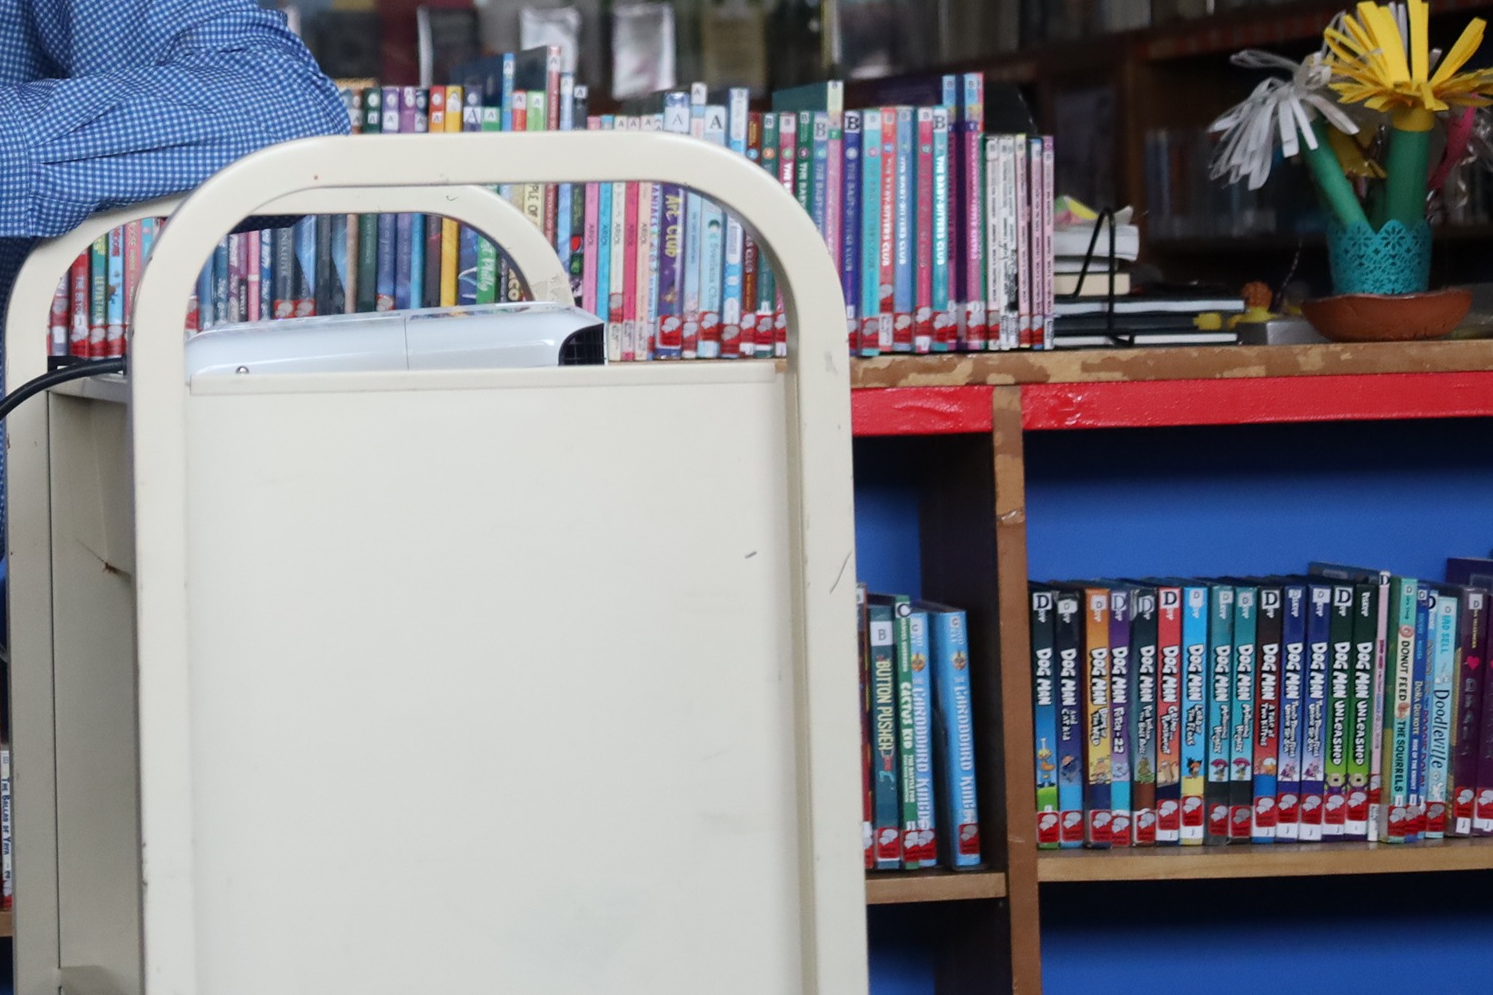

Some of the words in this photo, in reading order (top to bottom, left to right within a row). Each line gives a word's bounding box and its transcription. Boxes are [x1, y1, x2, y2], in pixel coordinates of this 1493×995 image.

[799, 162, 808, 179] THE
[937, 156, 945, 173] THE
[665, 195, 682, 222] Art
[936, 175, 945, 239] BABY-SITTERS
[665, 225, 682, 257] Club
[882, 242, 890, 266] CLUB
[937, 241, 945, 265] CLUB
[95, 276, 103, 317] LEVIATHA
[878, 629, 886, 640] B
[1440, 633, 1451, 654] SELL
[1036, 648, 1052, 677] DOG
[1060, 648, 1077, 677] DOG
[1090, 648, 1107, 677] DOG
[1112, 646, 1128, 675] DOG
[1139, 645, 1155, 673] DOG
[1162, 645, 1179, 673] DOG
[1187, 644, 1204, 671] DOG
[1214, 645, 1231, 672] DOG
[1237, 644, 1253, 672] DOG
[1262, 644, 1279, 672] DOG
[1286, 643, 1303, 670] DOG
[1310, 642, 1328, 669] DOG
[1333, 642, 1350, 669] DOG
[1355, 642, 1373, 669] DOG
[1399, 641, 1410, 674] DONUT
[875, 661, 892, 703] BUTTON
[1037, 679, 1052, 705] MAN
[1062, 680, 1076, 705] MAN
[1091, 679, 1107, 704] MAN
[1112, 677, 1127, 703] MAN
[1139, 676, 1154, 702] MAN
[1162, 674, 1178, 702] MAN
[1188, 674, 1203, 701] MAN
[1214, 674, 1229, 702] MAN
[1237, 674, 1252, 701] MAN
[1262, 673, 1278, 700] MAN
[1285, 672, 1300, 700] MAN
[1310, 672, 1325, 698] MAN
[1332, 672, 1348, 698] MAN
[1354, 672, 1370, 698] MAN
[1398, 677, 1409, 701] FEED
[901, 682, 912, 724] CACTUS
[877, 707, 894, 750] PUSHER
[902, 728, 913, 749] KID
[913, 688, 928, 772] CARDBOARD
[954, 687, 973, 770] CARDBOARD
[1397, 721, 1406, 738] THE
[1395, 740, 1405, 792] SQUIRRELS
